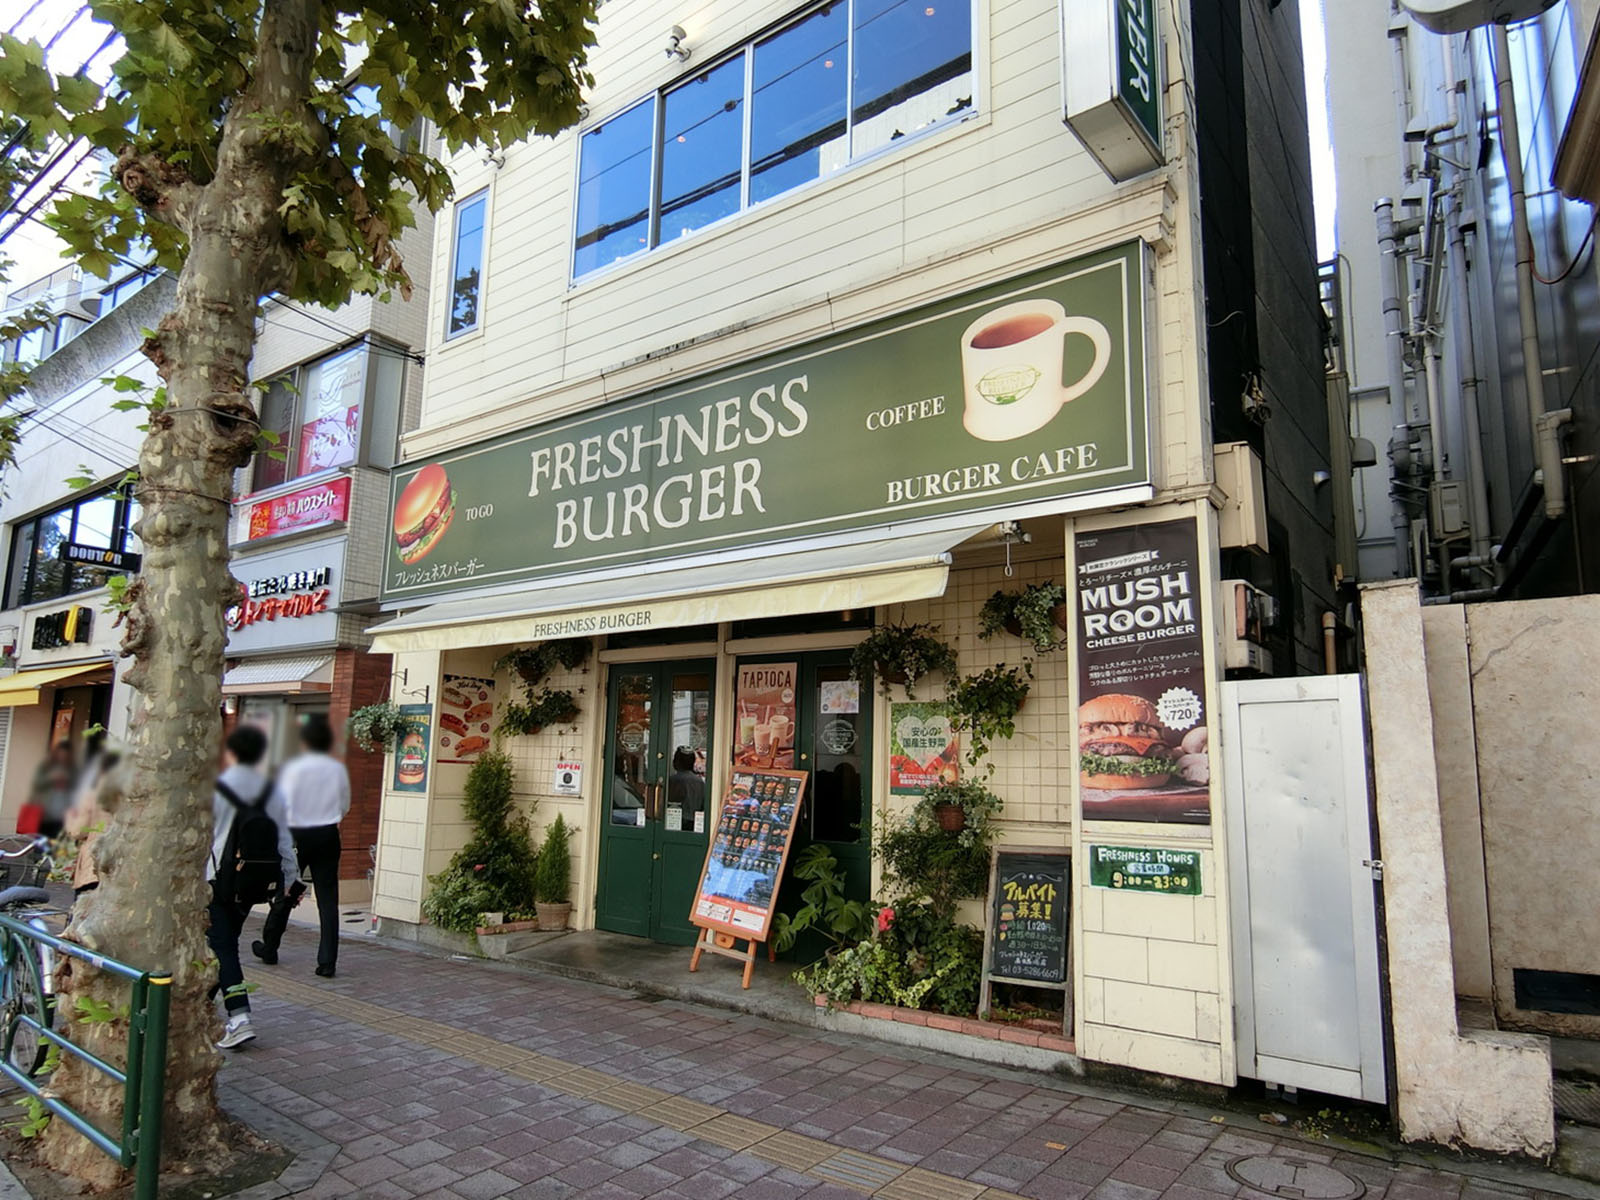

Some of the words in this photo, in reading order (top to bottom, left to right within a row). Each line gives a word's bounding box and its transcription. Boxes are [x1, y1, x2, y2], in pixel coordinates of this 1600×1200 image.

[866, 396, 946, 431] COFFEE
[528, 375, 809, 497] FRESHNESS
[886, 462, 1002, 503] BURGER
[1010, 442, 1099, 482] CAFE
[553, 458, 766, 549] BURGER
[69, 546, 122, 565] DOUTOR
[394, 557, 486, 586] フレッシュネスバーガー
[1080, 571, 1191, 612] MUSH
[533, 616, 597, 637] FRESHNESS
[598, 610, 652, 631] BURGER
[1083, 598, 1194, 638] ROOM
[1086, 634, 1136, 649] CHEESE
[1137, 624, 1196, 641] BURGER
[743, 670, 792, 689] TAPIOCA
[557, 763, 581, 771] OPEN
[1097, 847, 1151, 863] FRESHNESS
[1002, 881, 1057, 902] アルバイト
